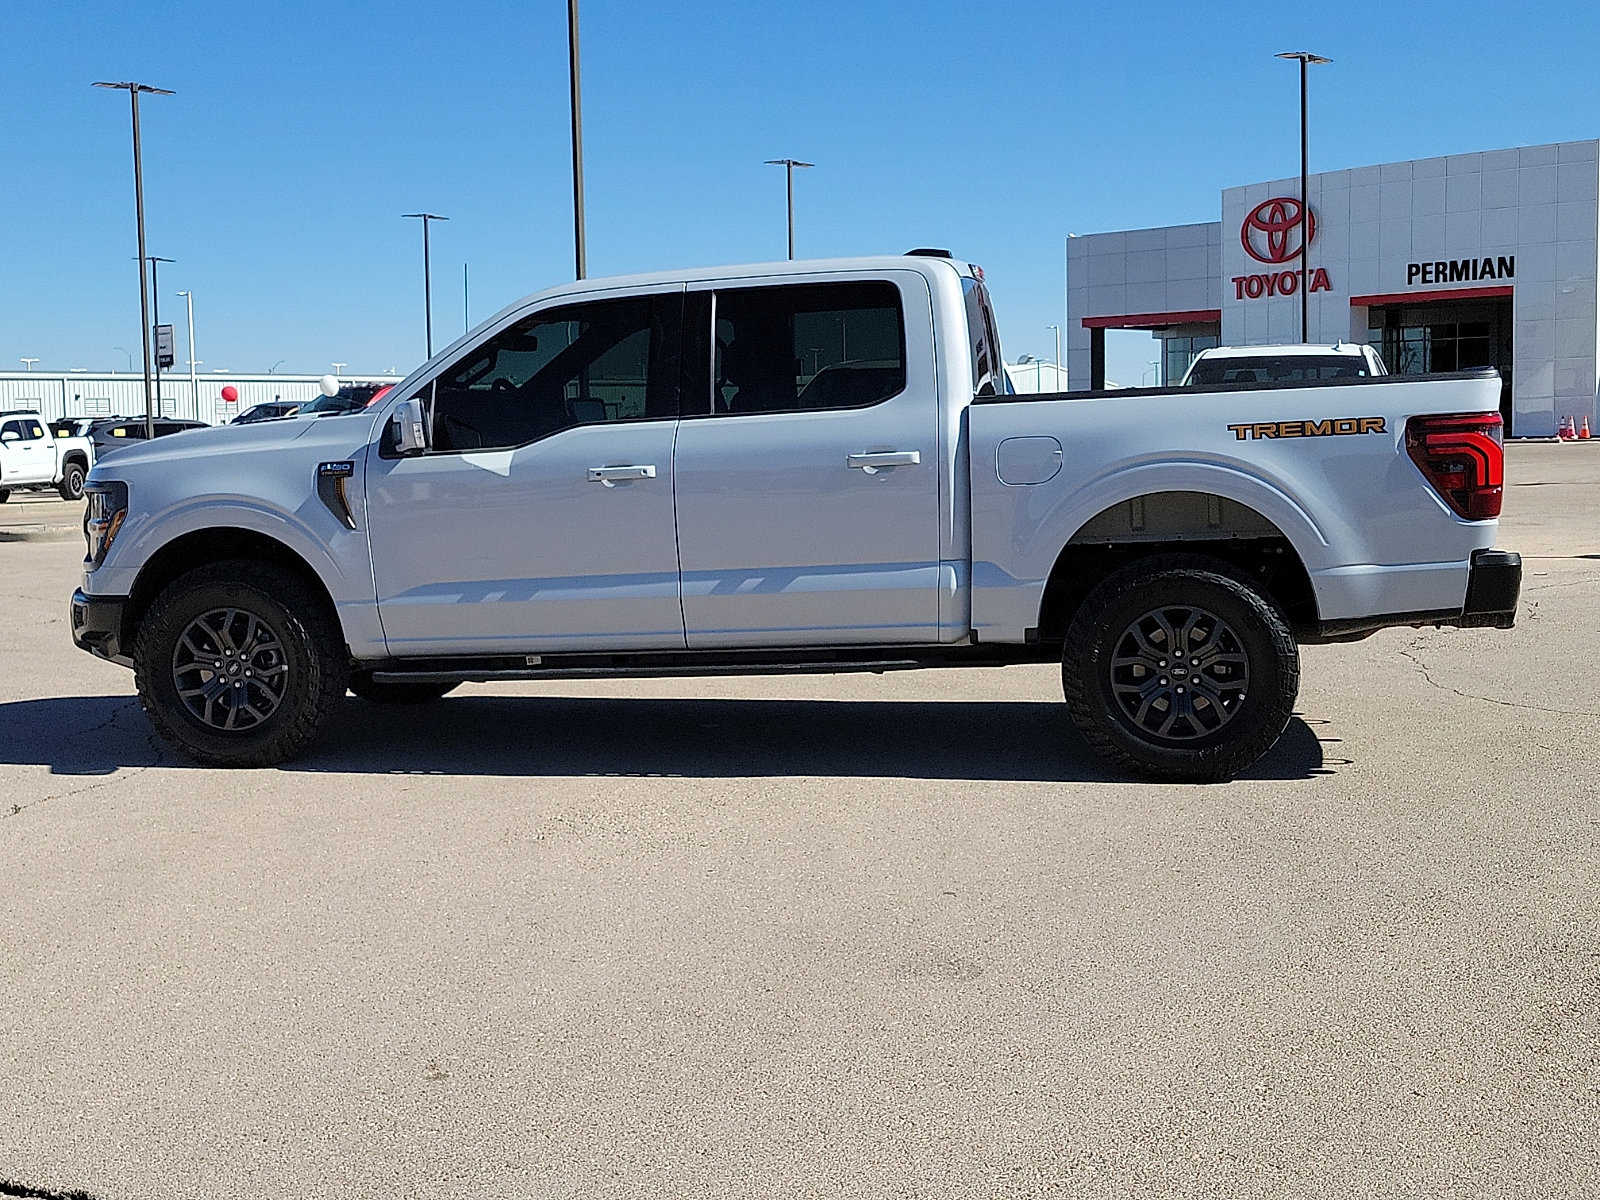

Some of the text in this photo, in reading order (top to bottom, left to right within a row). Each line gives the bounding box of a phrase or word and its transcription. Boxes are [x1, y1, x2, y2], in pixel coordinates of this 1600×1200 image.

[1232, 267, 1332, 300] TOYOA
[1407, 256, 1515, 285] PERMIAN
[1227, 417, 1388, 440] TREMOR
